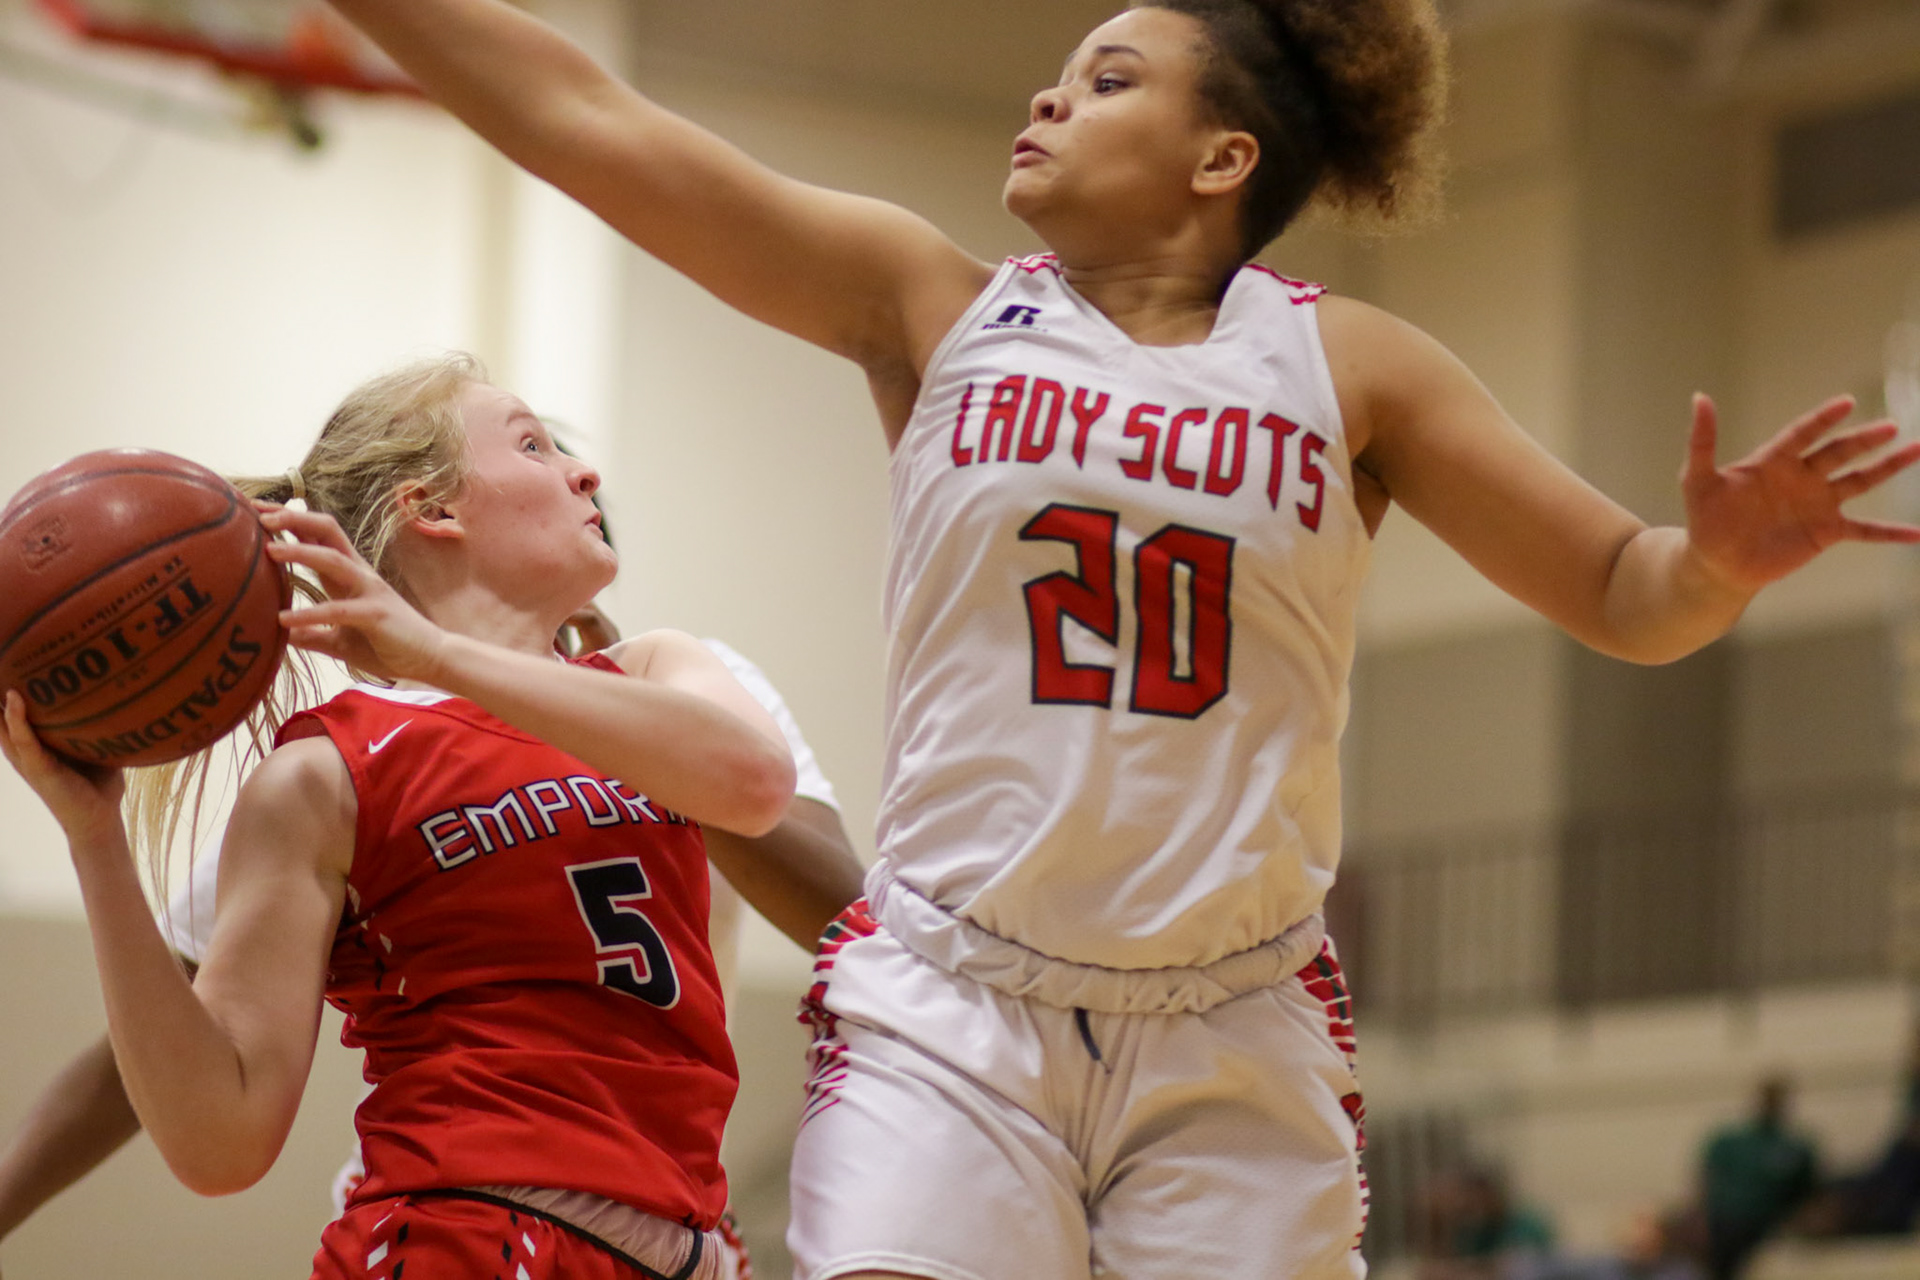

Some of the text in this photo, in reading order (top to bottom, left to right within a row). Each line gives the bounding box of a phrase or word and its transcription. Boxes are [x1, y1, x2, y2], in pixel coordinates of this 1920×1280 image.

[950, 374, 1328, 534] LADY SCOTS
[1018, 502, 1237, 721] 20
[415, 774, 701, 873] EMPOR
[564, 856, 681, 1011] 5
